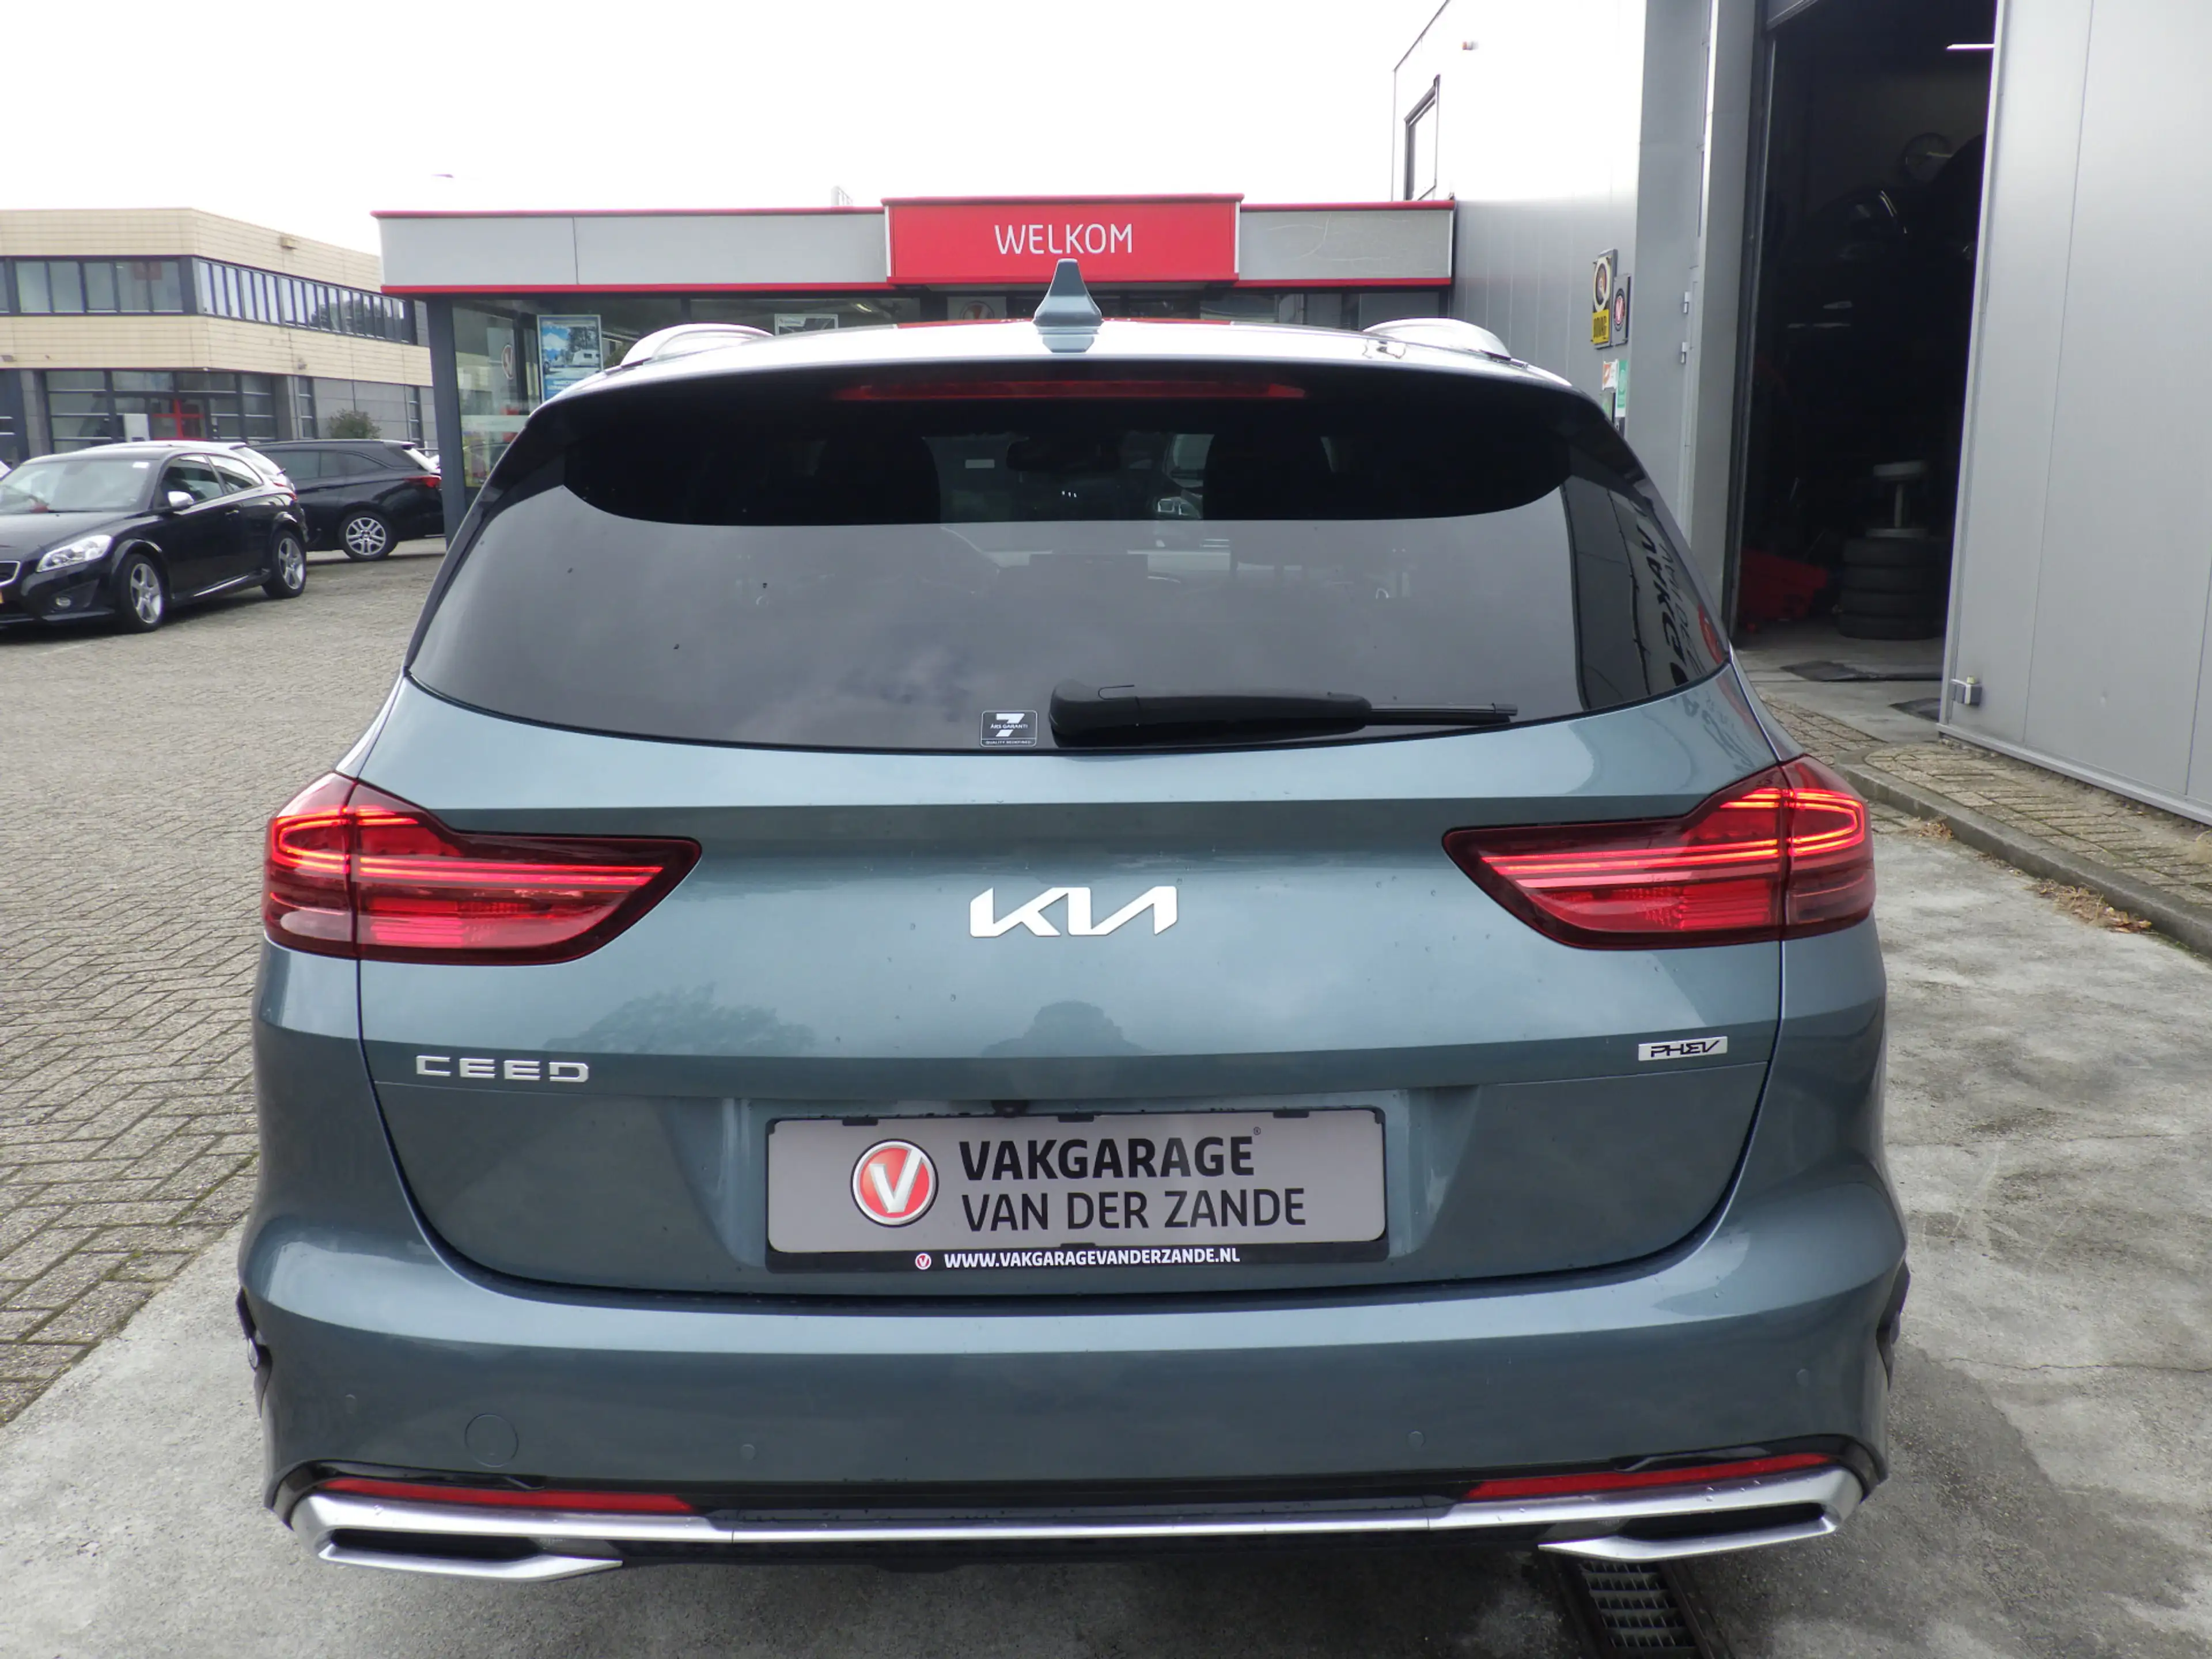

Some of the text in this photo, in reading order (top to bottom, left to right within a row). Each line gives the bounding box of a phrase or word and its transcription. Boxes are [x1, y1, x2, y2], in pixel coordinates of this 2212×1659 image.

[994, 223, 1132, 254] WELKOM
[995, 713, 1025, 737] 7
[969, 886, 1177, 938] KIA
[1650, 1040, 1719, 1058] PHEV
[416, 1055, 589, 1082] CEED
[959, 1136, 1254, 1181] VAKGARAGE
[961, 1188, 1306, 1232] VAN DER ZANDE
[944, 1248, 1240, 1268] WWW.VAKGARAGEVANDERZANDE.NL
